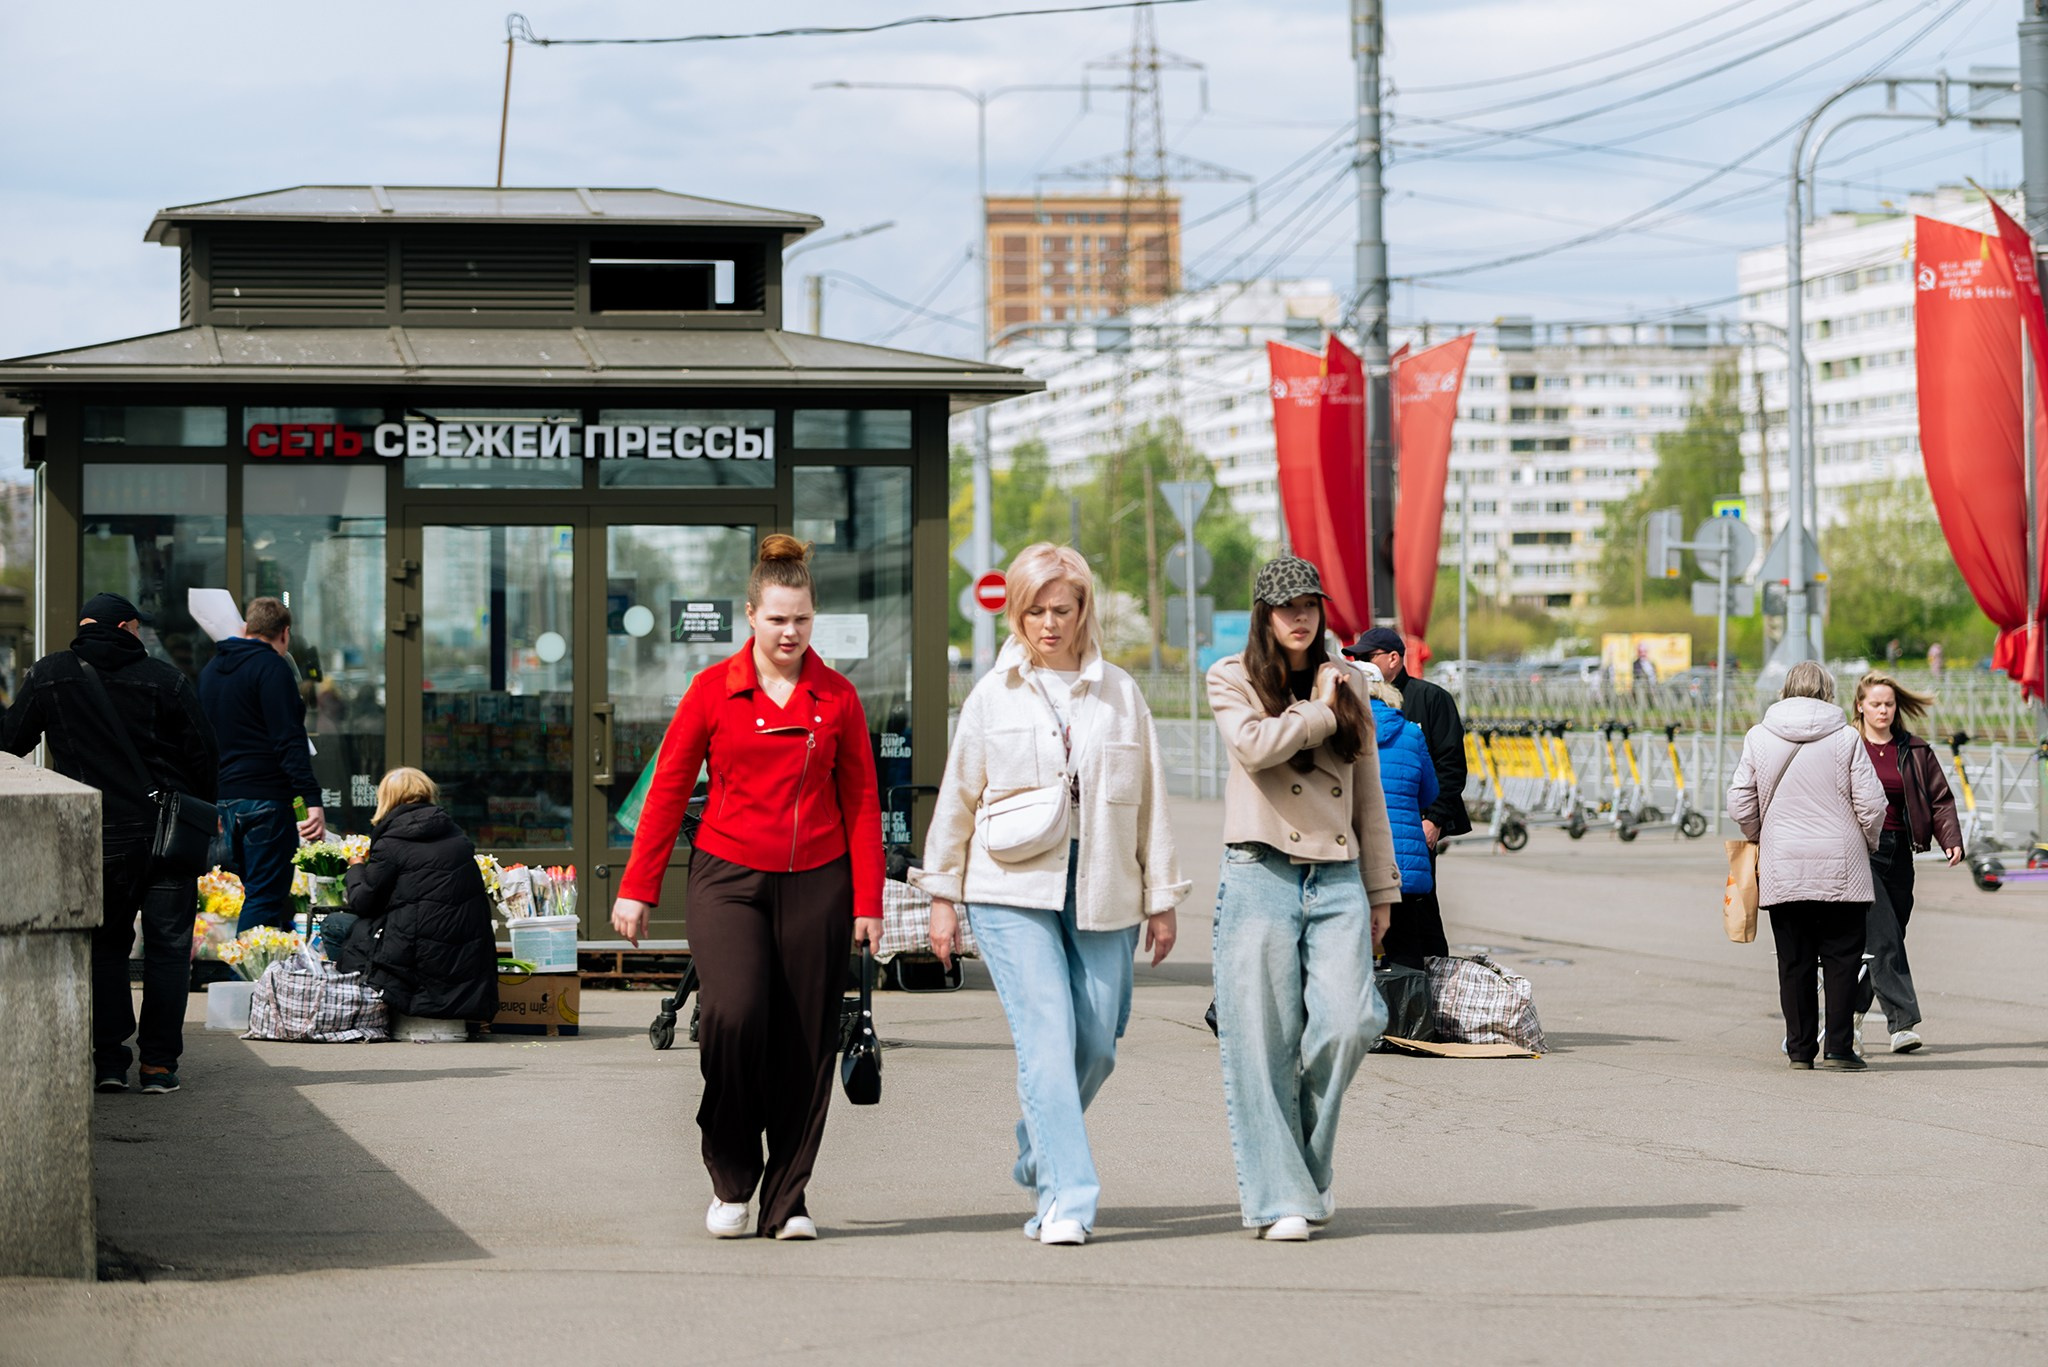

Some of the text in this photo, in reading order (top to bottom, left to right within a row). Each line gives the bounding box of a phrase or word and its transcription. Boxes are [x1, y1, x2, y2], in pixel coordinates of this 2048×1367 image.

[247, 416, 774, 460] СЕТЬ СВЕЖЕЙ ПРЕССЫ
[880, 736, 906, 747] JUMP
[880, 747, 912, 758] AHEAD
[351, 774, 371, 785] ONE
[331, 790, 342, 807] ALL
